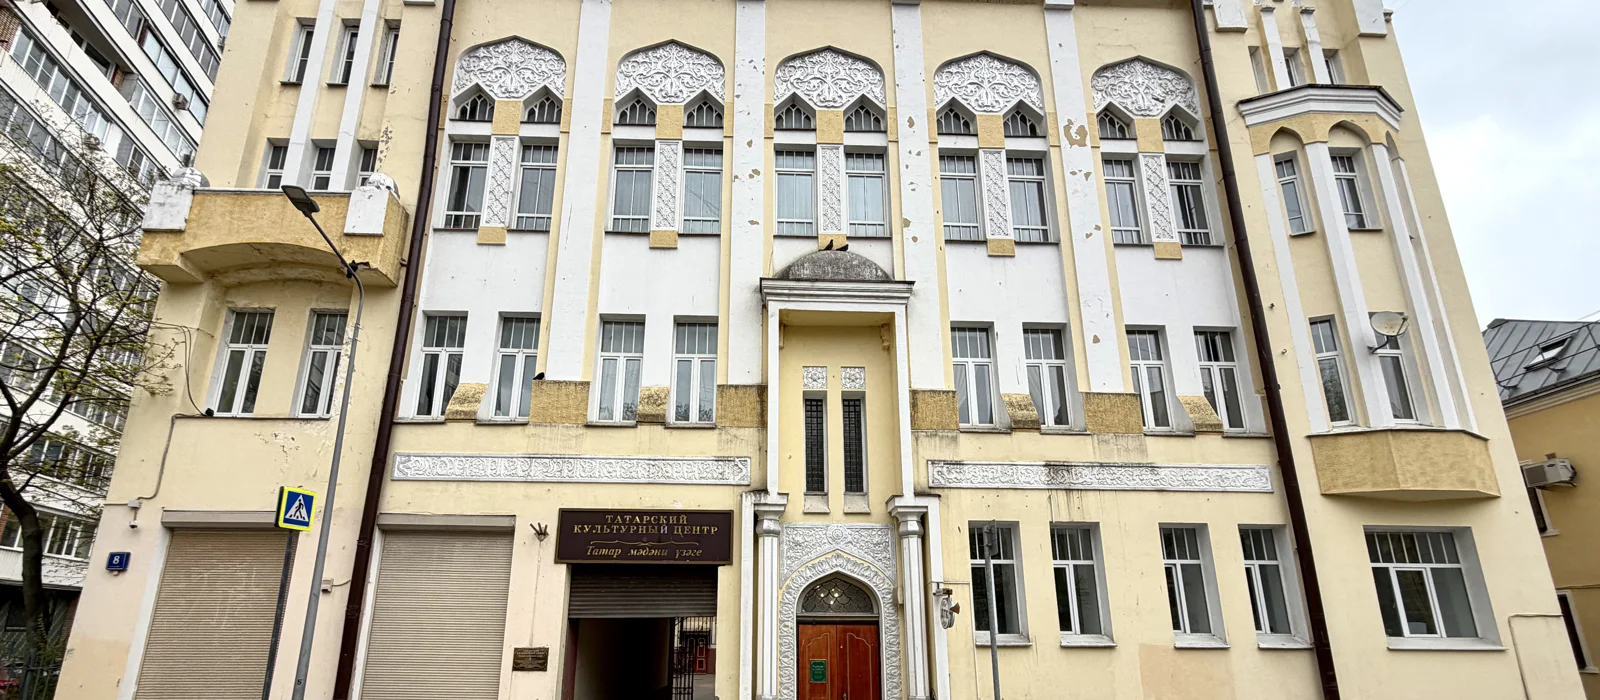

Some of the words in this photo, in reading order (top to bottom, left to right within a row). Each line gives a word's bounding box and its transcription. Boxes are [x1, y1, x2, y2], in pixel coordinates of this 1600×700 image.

[605, 514, 688, 524] ТАТАРСКИЙ
[573, 524, 669, 534] КУЛЬТУРНЫЙ
[673, 525, 719, 537] ЦЕНТР
[586, 546, 622, 558] Татар
[627, 547, 669, 557] мәдәни
[675, 549, 703, 559] үзәге
[112, 555, 120, 564] 8
